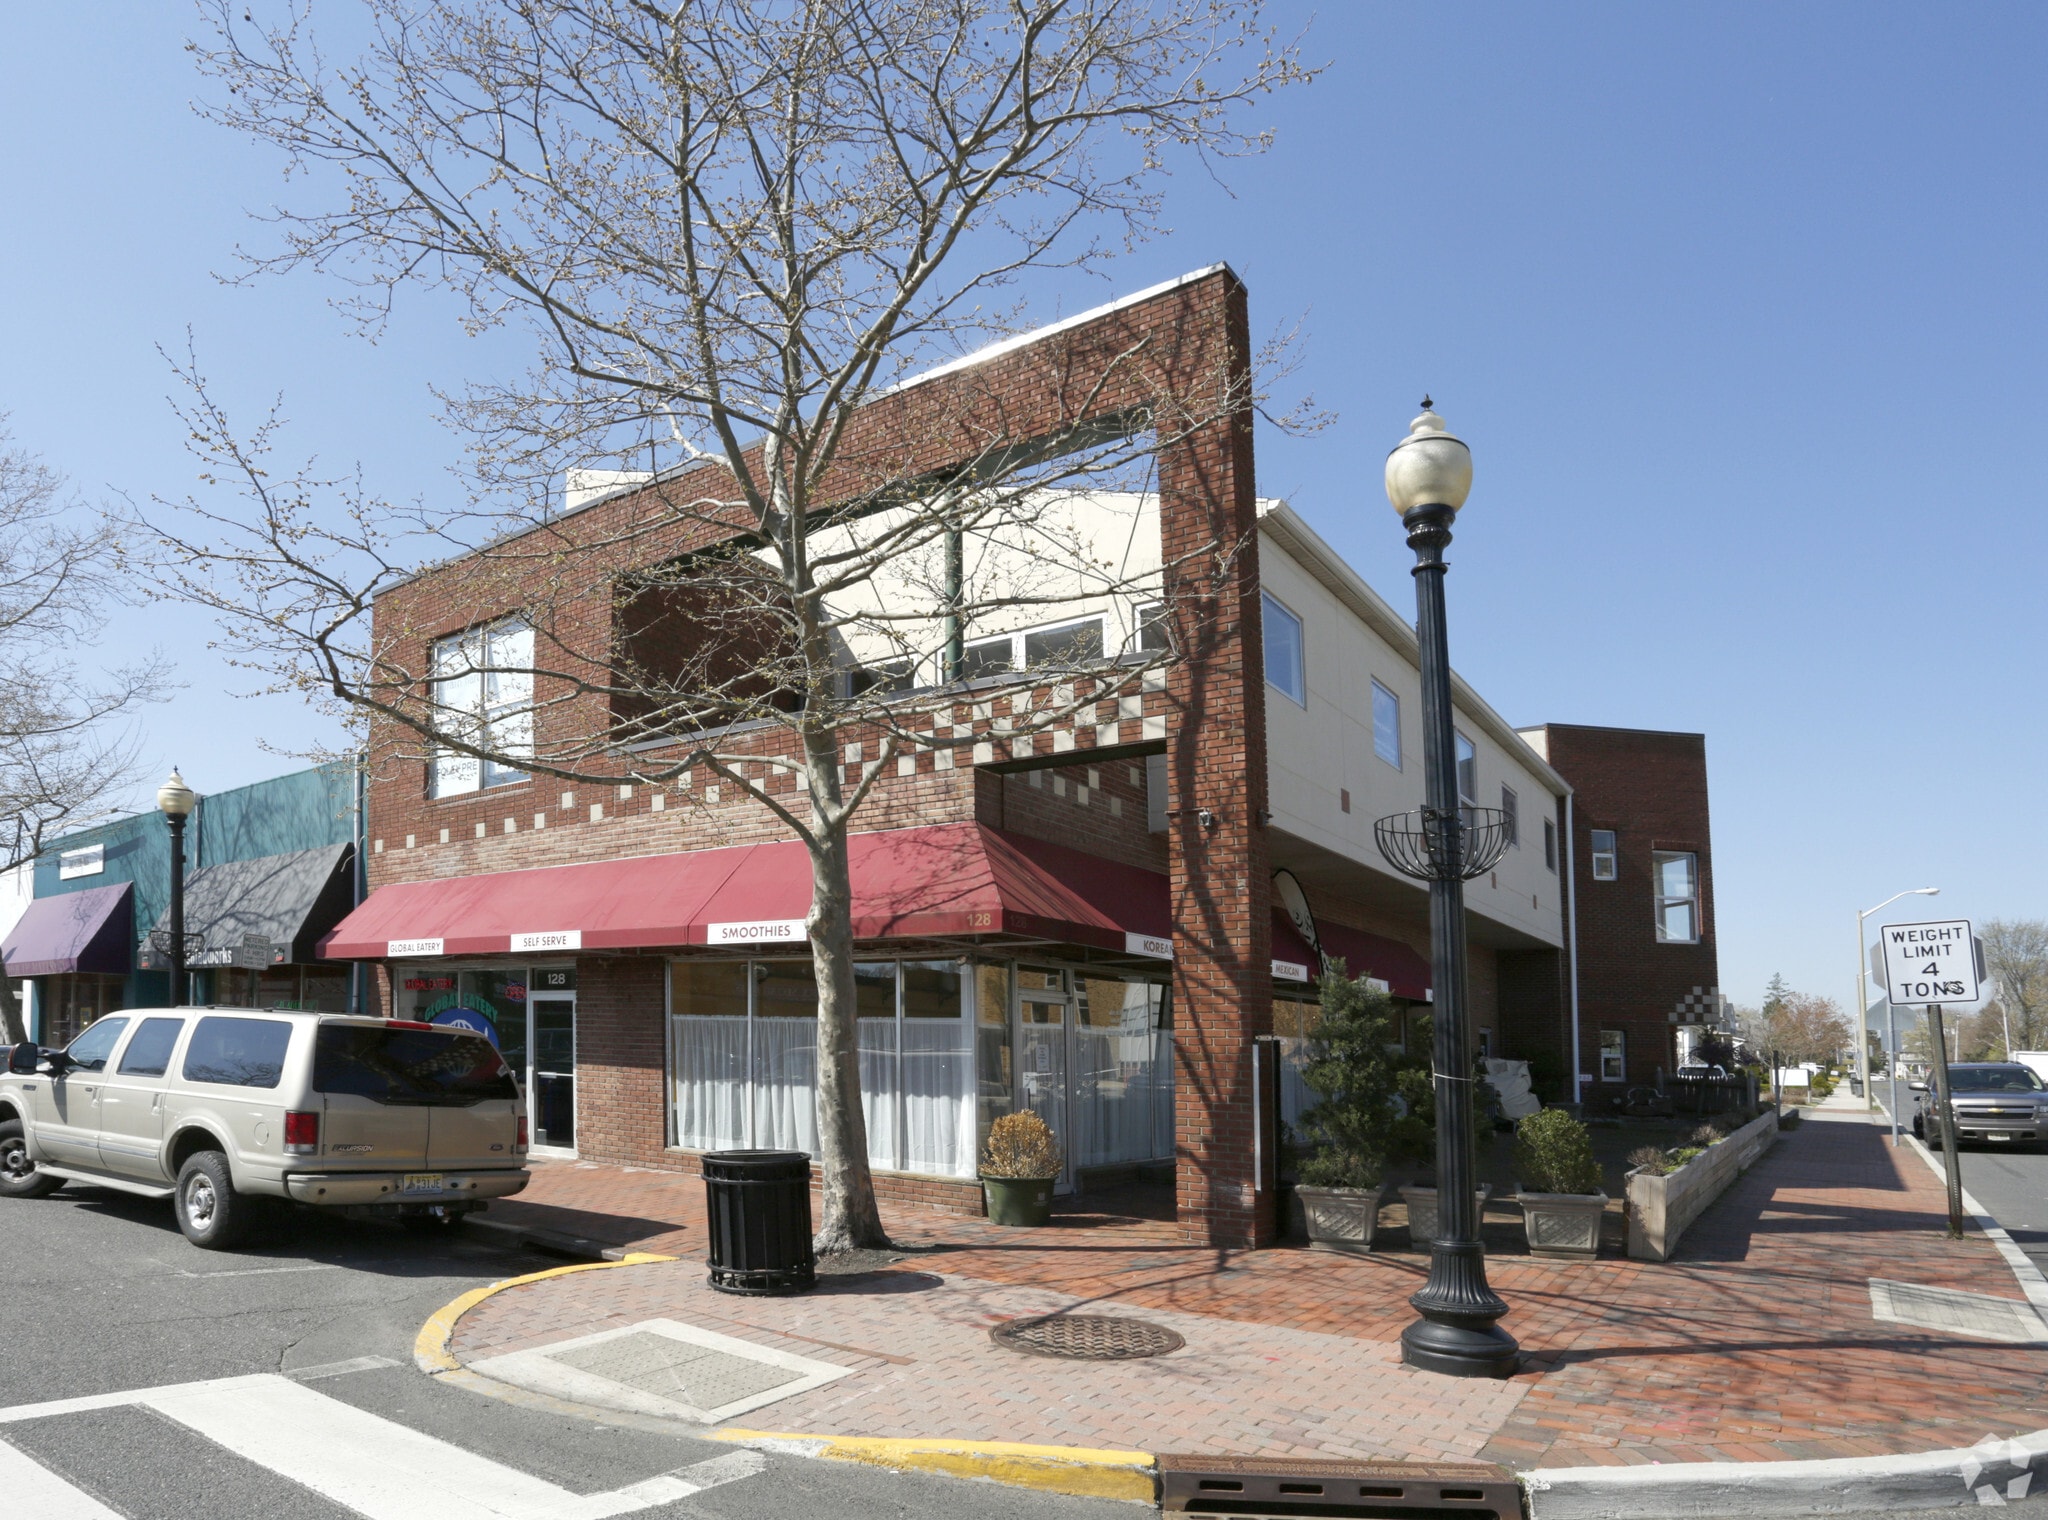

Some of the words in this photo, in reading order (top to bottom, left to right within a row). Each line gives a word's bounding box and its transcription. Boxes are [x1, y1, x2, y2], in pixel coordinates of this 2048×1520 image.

[967, 913, 991, 927] 128
[722, 925, 791, 939] SMOOTHIES
[1892, 927, 1963, 943] WEIGHT
[390, 944, 415, 953] GLOBAL
[416, 942, 441, 952] EATERY
[523, 937, 540, 948] SELF
[542, 936, 567, 947] SERVE
[1903, 944, 1952, 958] LIMIT
[1276, 963, 1300, 977] MEXICAN
[1921, 962, 1940, 976] 4
[547, 973, 566, 985] 128
[1900, 980, 1965, 997] TONS
[424, 992, 459, 1022] GLOBAL
[463, 993, 498, 1024] EATERY
